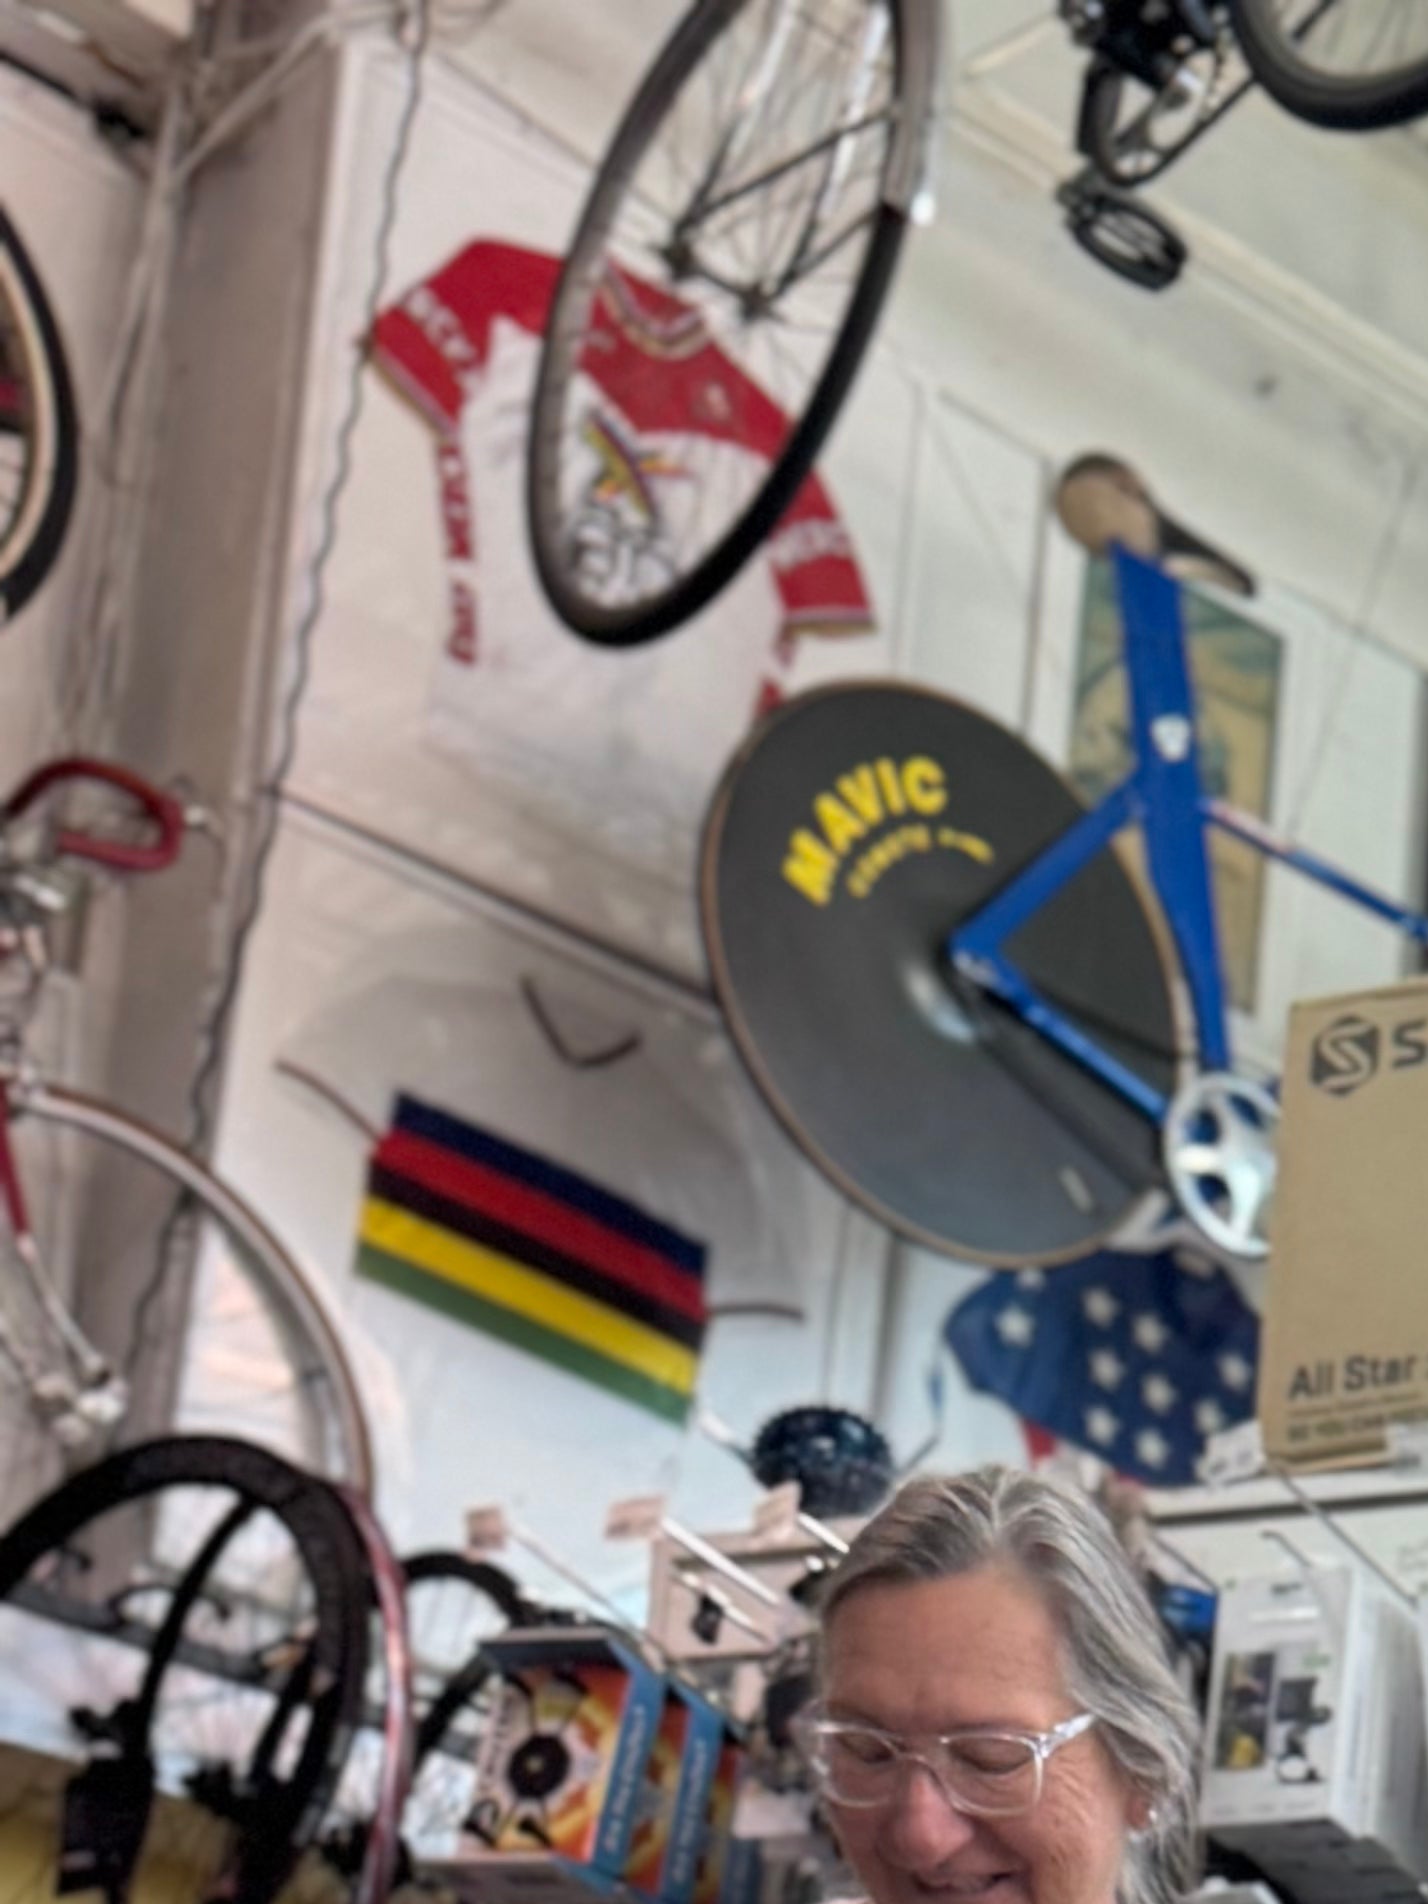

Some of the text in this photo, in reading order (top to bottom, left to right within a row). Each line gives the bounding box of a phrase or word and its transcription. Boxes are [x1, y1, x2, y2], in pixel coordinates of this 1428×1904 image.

[783, 755, 948, 905] MAVIC
[1288, 1361, 1334, 1401] All
[1343, 1353, 1418, 1391] Star
